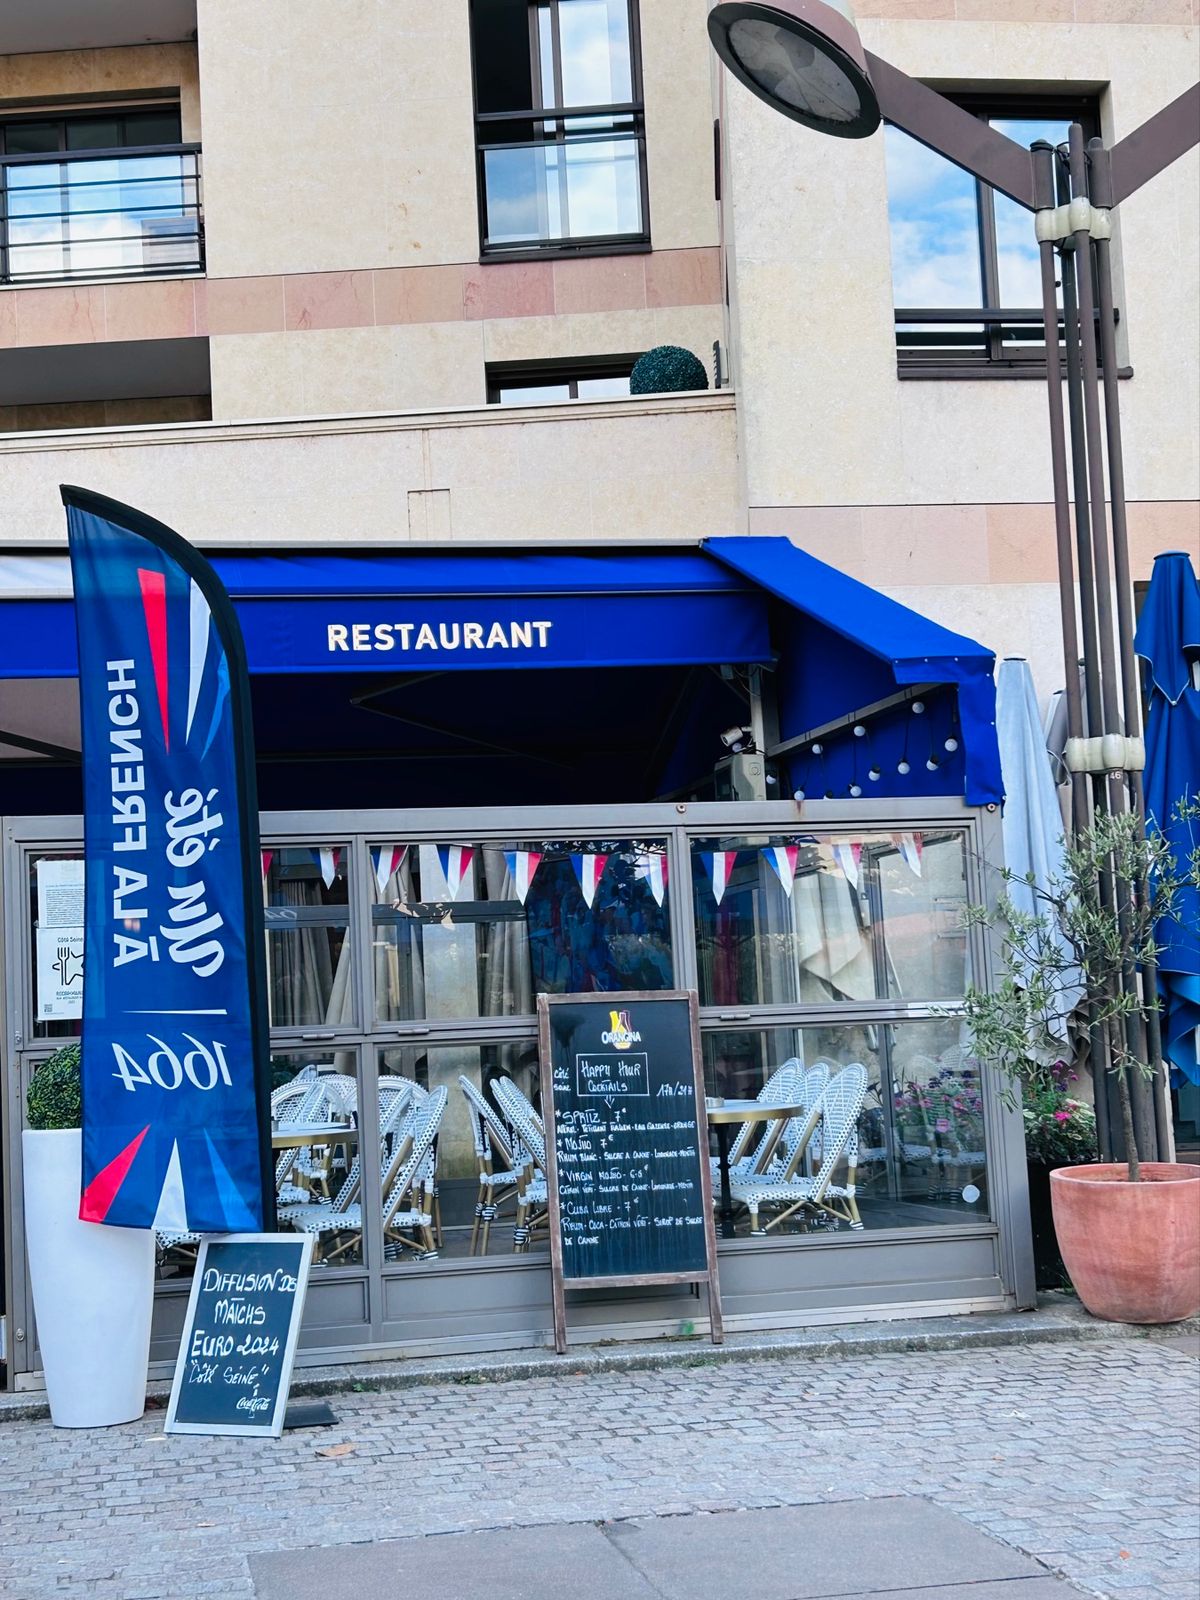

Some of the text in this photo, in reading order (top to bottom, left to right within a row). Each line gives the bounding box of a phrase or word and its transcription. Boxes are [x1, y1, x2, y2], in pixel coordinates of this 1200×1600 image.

[327, 621, 552, 651] RESTAURANT
[601, 1031, 642, 1044] ORANGINA
[203, 1268, 283, 1293] DIFFUSION
[214, 1297, 266, 1325] MATCHS
[191, 1329, 279, 1357] EURO 2024
